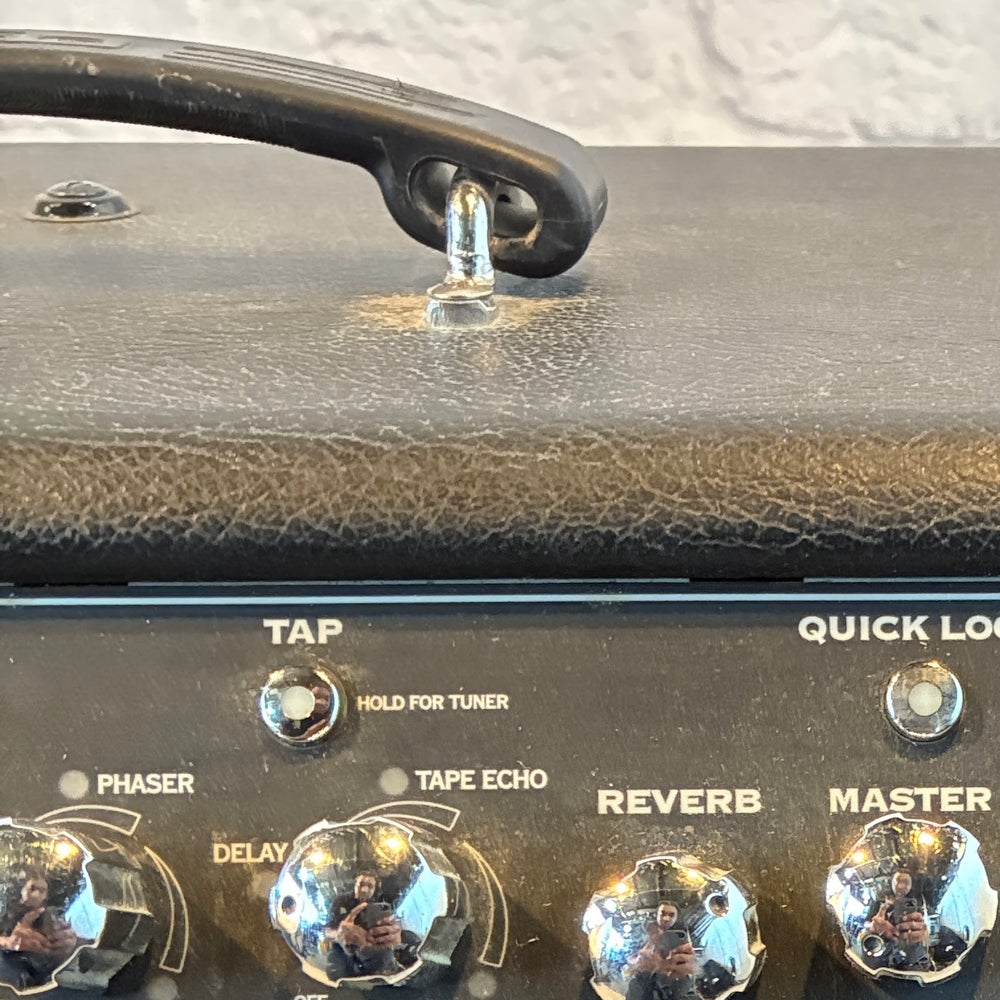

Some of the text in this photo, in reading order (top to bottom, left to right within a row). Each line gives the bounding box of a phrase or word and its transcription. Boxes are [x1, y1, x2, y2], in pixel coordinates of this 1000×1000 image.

[263, 618, 343, 645] TAP
[798, 615, 928, 643] QUICK
[357, 693, 509, 711] HOLD FOR TUNER
[97, 773, 195, 795] PHASER
[415, 768, 548, 791] TAPE ECHO
[597, 788, 763, 815] REVERB
[829, 786, 992, 813] MASTER
[213, 842, 289, 864] DELAY
